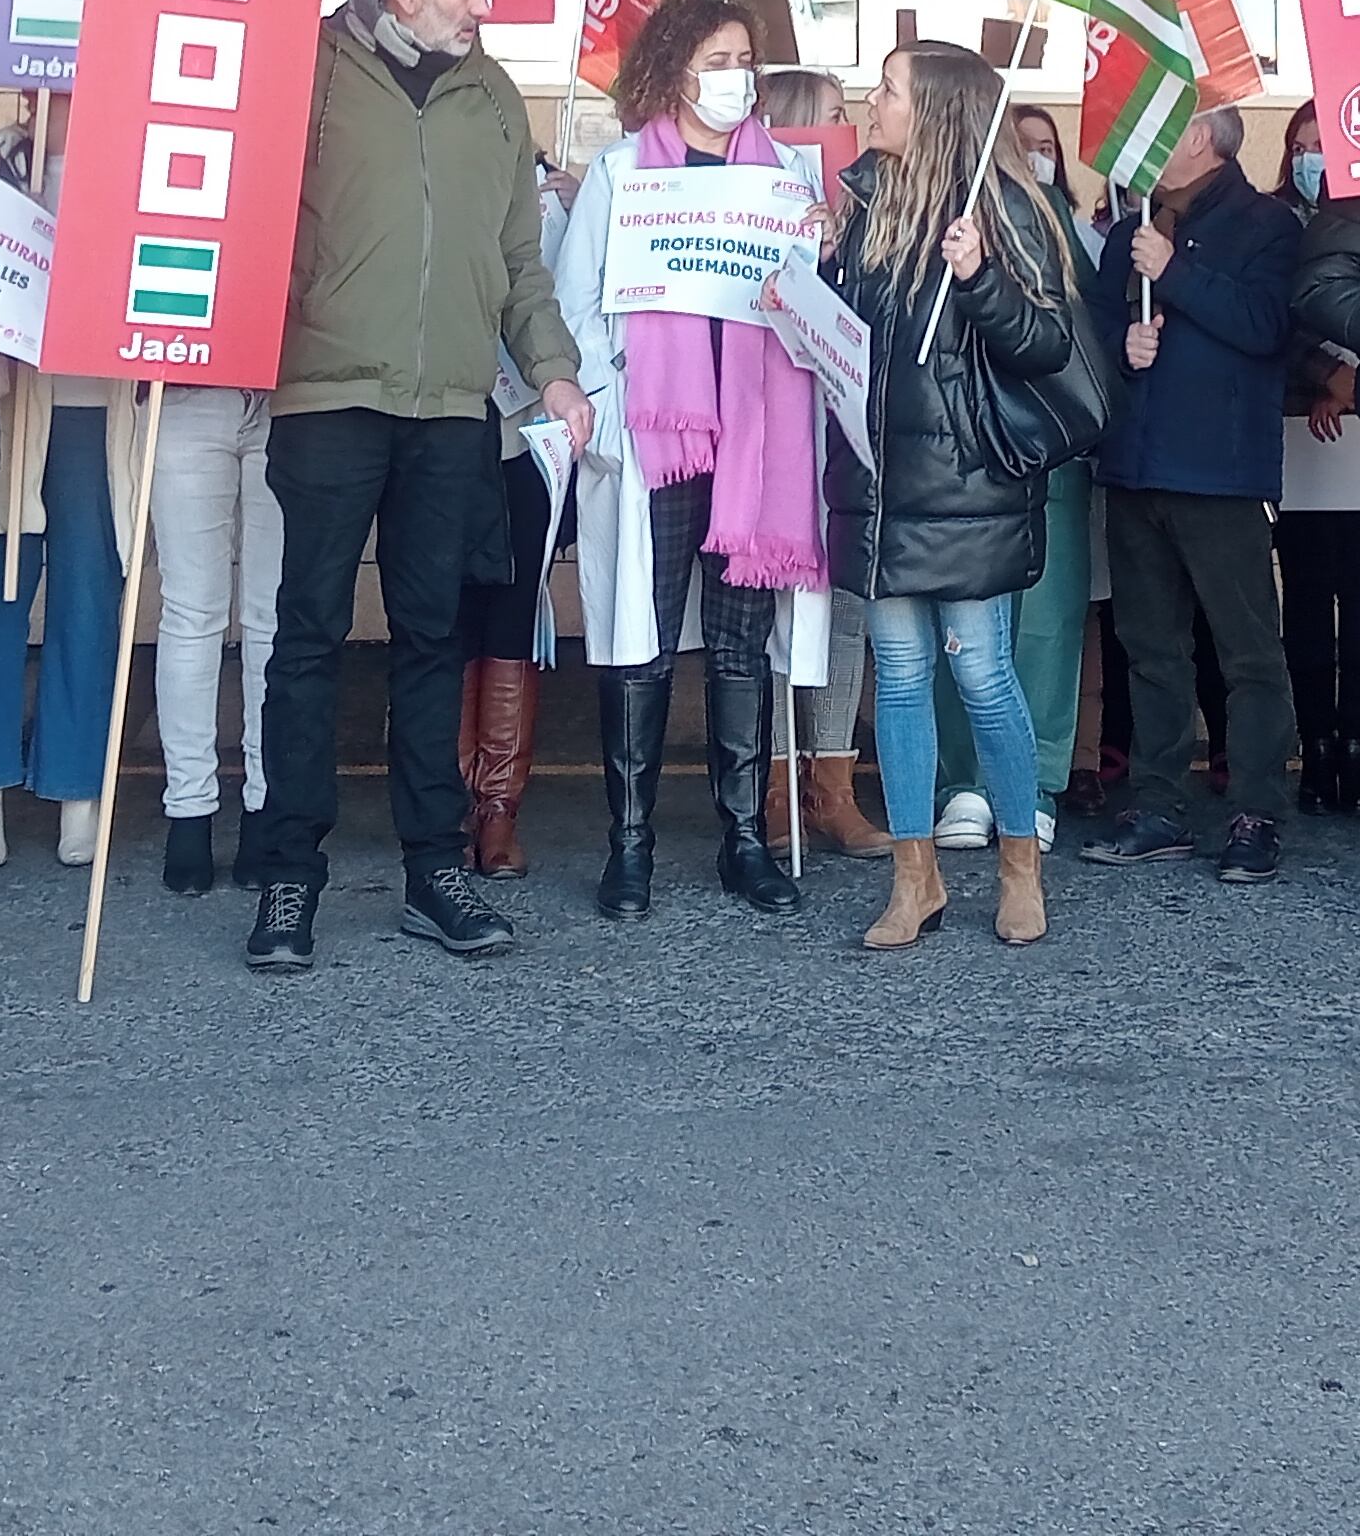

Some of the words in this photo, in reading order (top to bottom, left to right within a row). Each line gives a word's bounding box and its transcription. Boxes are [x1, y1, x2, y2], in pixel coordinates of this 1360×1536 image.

[12, 53, 76, 79] Jaén
[620, 211, 716, 228] URGENCIAS
[723, 211, 816, 240] SATURADAS
[650, 237, 780, 263] PROFESIONALES
[667, 257, 762, 282] QUEMADOS
[119, 331, 211, 365] Jaén
[810, 328, 863, 388] SATURADAS
